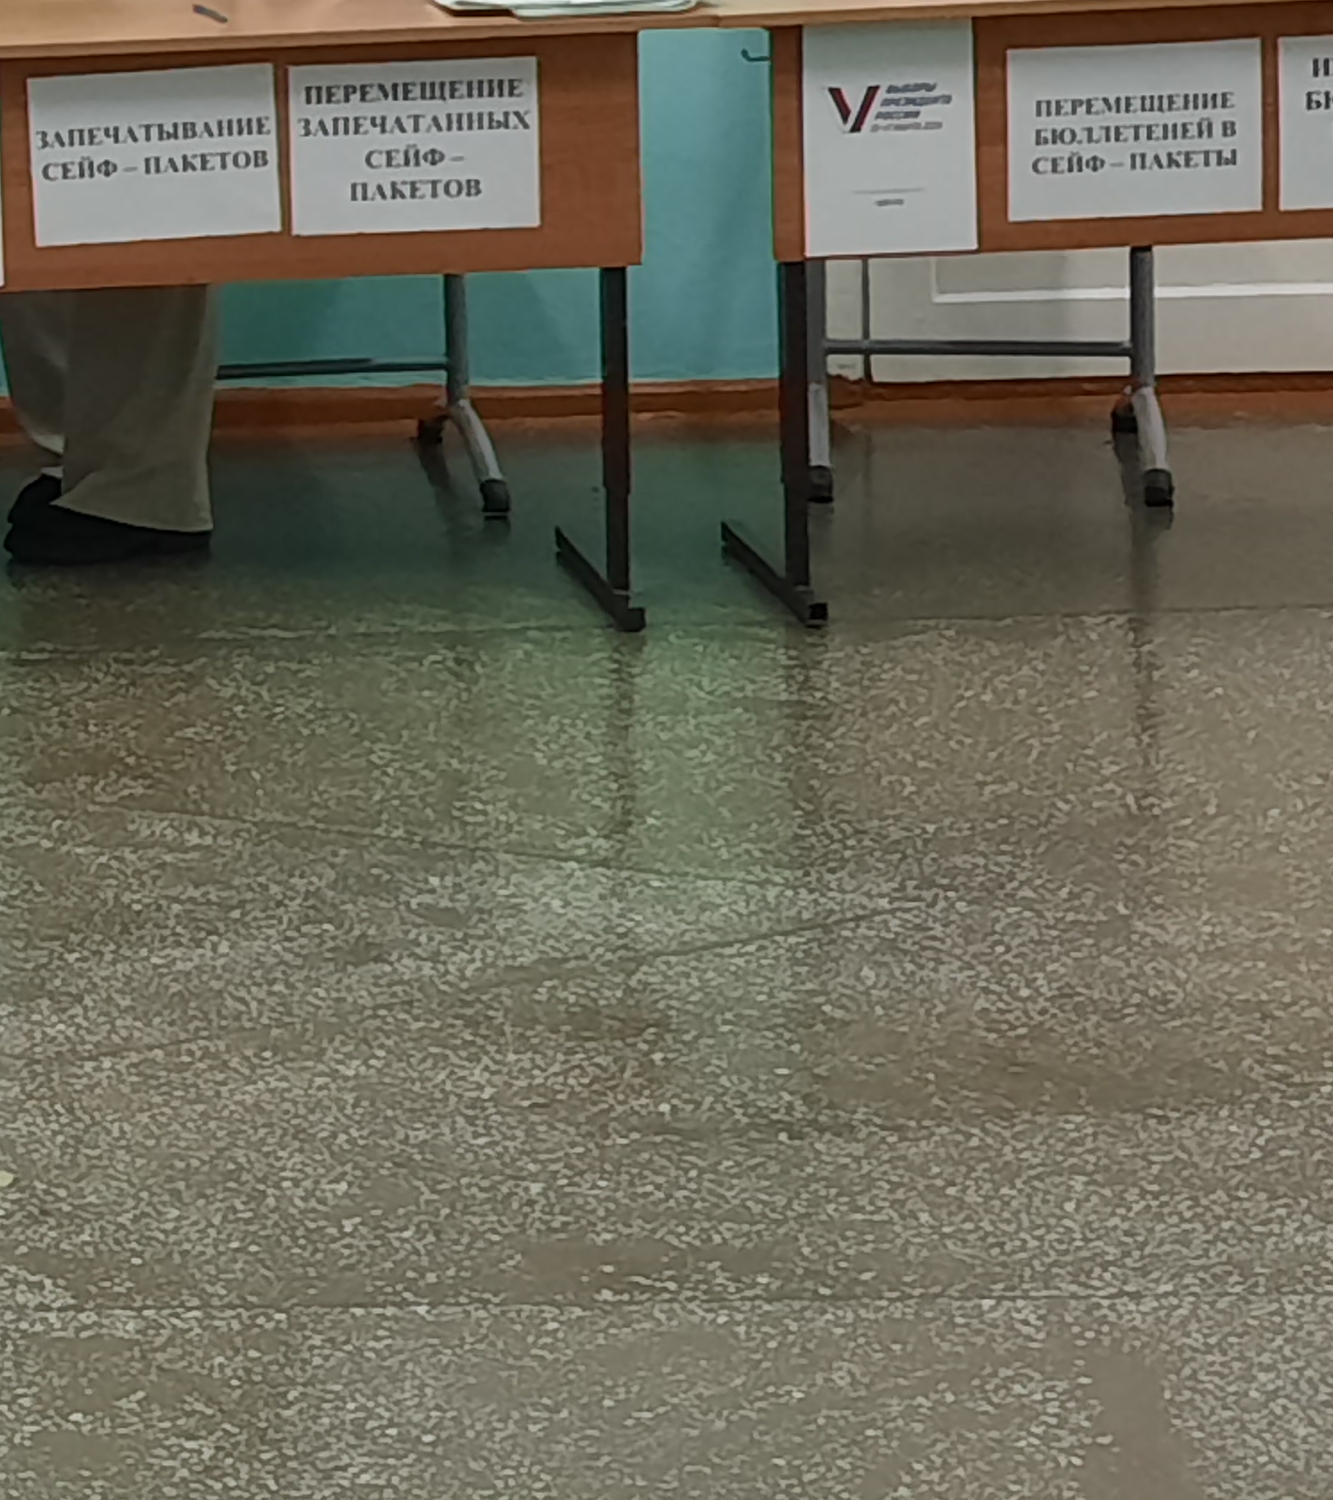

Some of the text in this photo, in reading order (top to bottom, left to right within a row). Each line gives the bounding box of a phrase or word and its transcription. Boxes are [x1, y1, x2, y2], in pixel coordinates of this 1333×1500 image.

[304, 78, 525, 105] ПЕРЕМЕЩЕНИЕ
[1035, 91, 1236, 118] ПЕРЕМЕЩЕНИЕ
[35, 115, 272, 151] ЗАПЕЧАТЫВАНИЕ
[297, 109, 531, 138] ЗАПЕЧАТАННЫХ
[1034, 116, 1237, 147] БЮЛЛЕТЕНЕЙ В
[41, 155, 119, 182] СЕЙФ
[143, 149, 269, 176] ПАКЕТОВ
[364, 143, 446, 170] СЕЙФ
[1031, 151, 1106, 175] СЕЙФ
[1129, 148, 1238, 172] ПАКЕТЫ
[349, 178, 483, 202] ПАКЕТОВ
